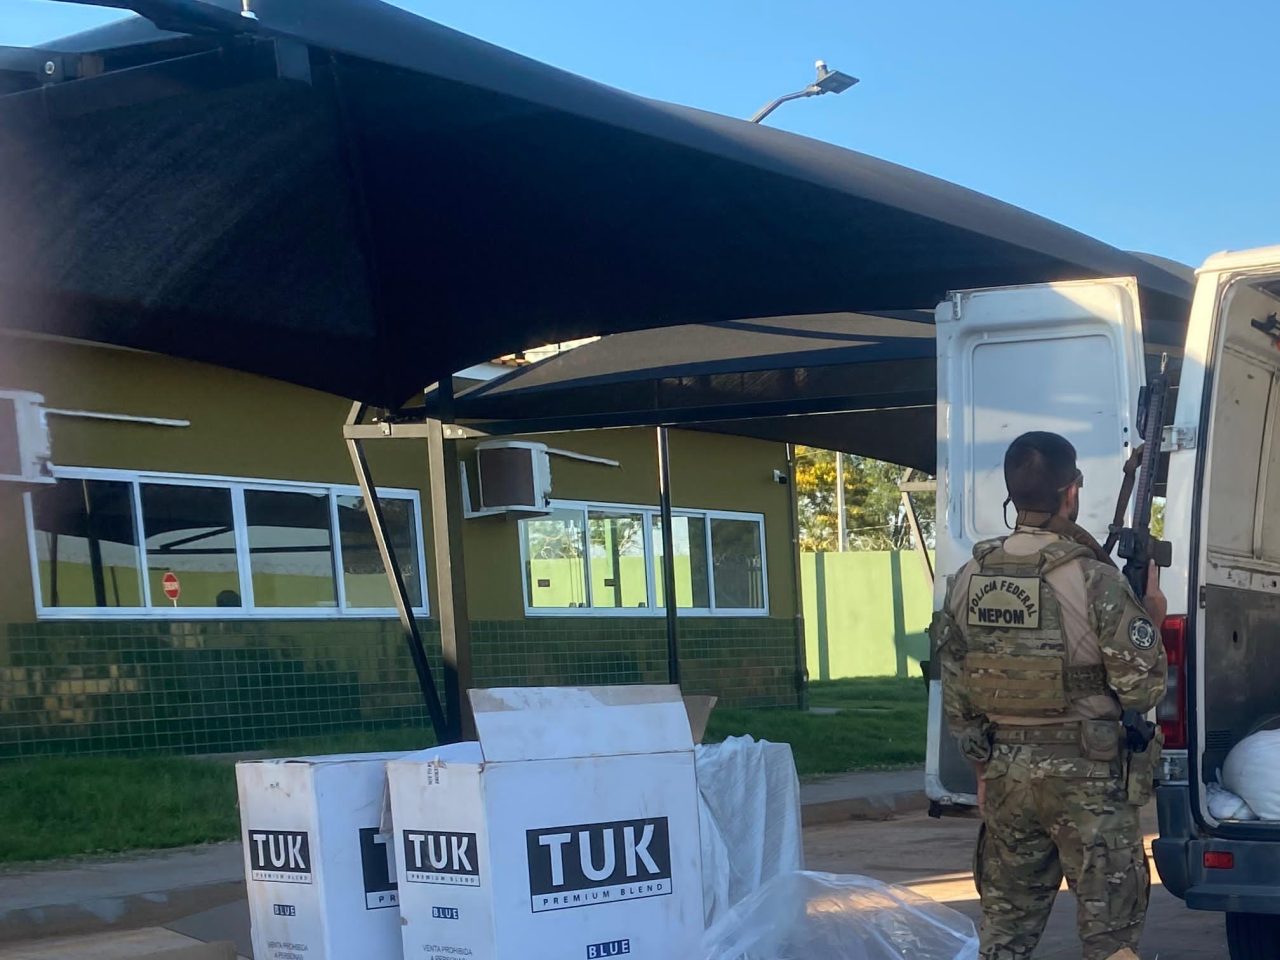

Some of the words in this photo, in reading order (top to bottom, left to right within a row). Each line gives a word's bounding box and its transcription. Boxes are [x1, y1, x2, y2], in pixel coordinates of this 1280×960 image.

[999, 580, 1038, 618] FEDERAL
[977, 607, 1025, 625] NEPOM
[252, 833, 306, 869] TUK
[408, 833, 473, 871] TUK
[538, 824, 661, 887] TUK
[543, 891, 610, 906] PREMIUM
[620, 883, 664, 896] BLEND
[274, 905, 296, 916] BLUE
[433, 907, 459, 919] BLUE
[588, 940, 630, 959] BLUE
